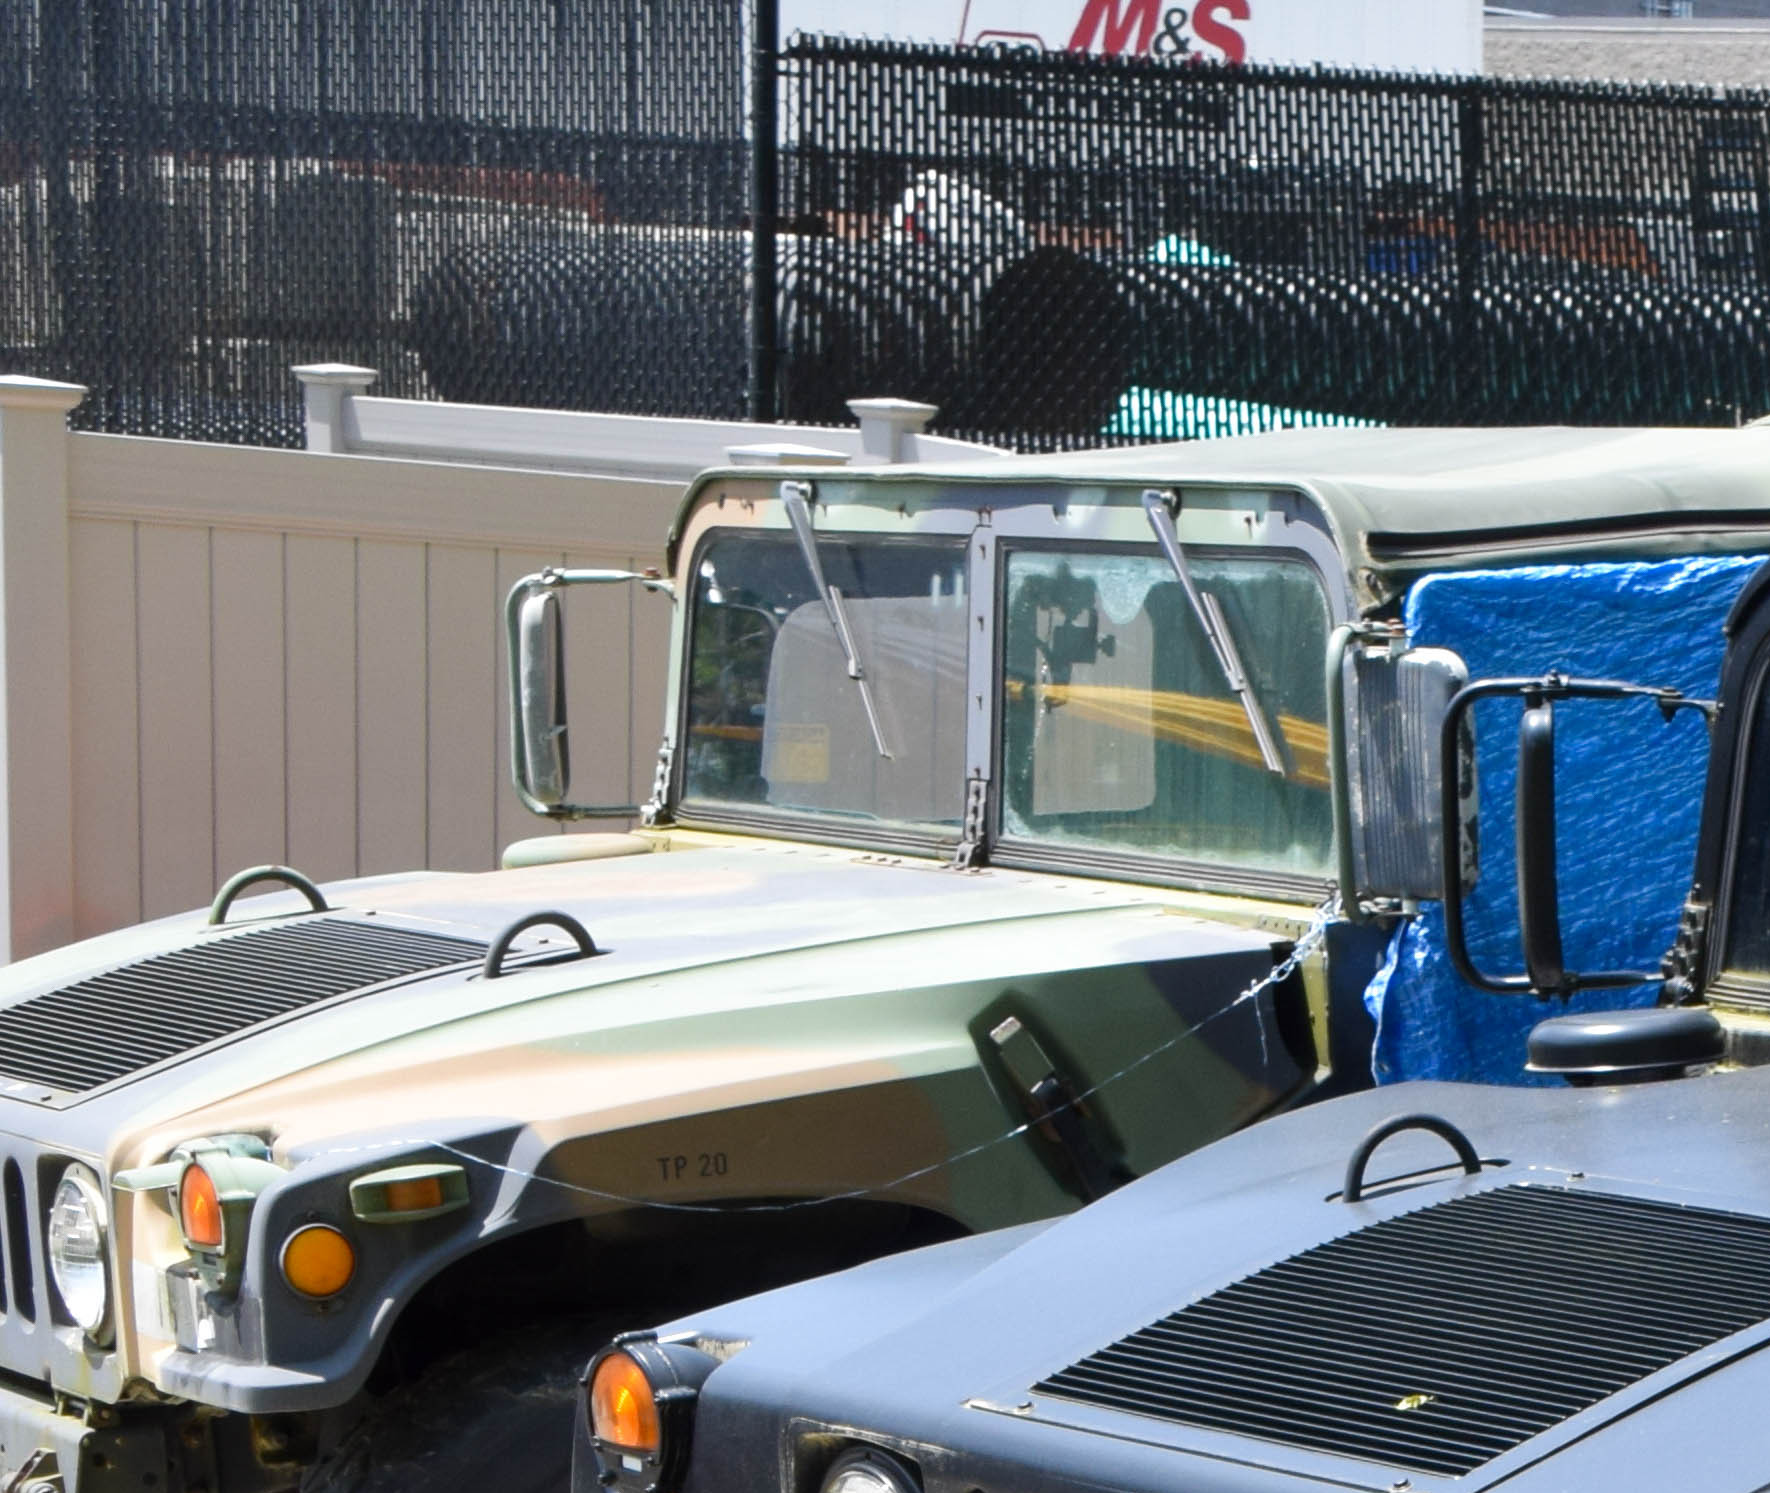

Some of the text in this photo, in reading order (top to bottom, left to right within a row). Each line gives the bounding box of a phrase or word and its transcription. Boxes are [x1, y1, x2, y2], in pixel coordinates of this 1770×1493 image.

[1066, 0, 1251, 65] M&S
[657, 1152, 729, 1181] TP 20
